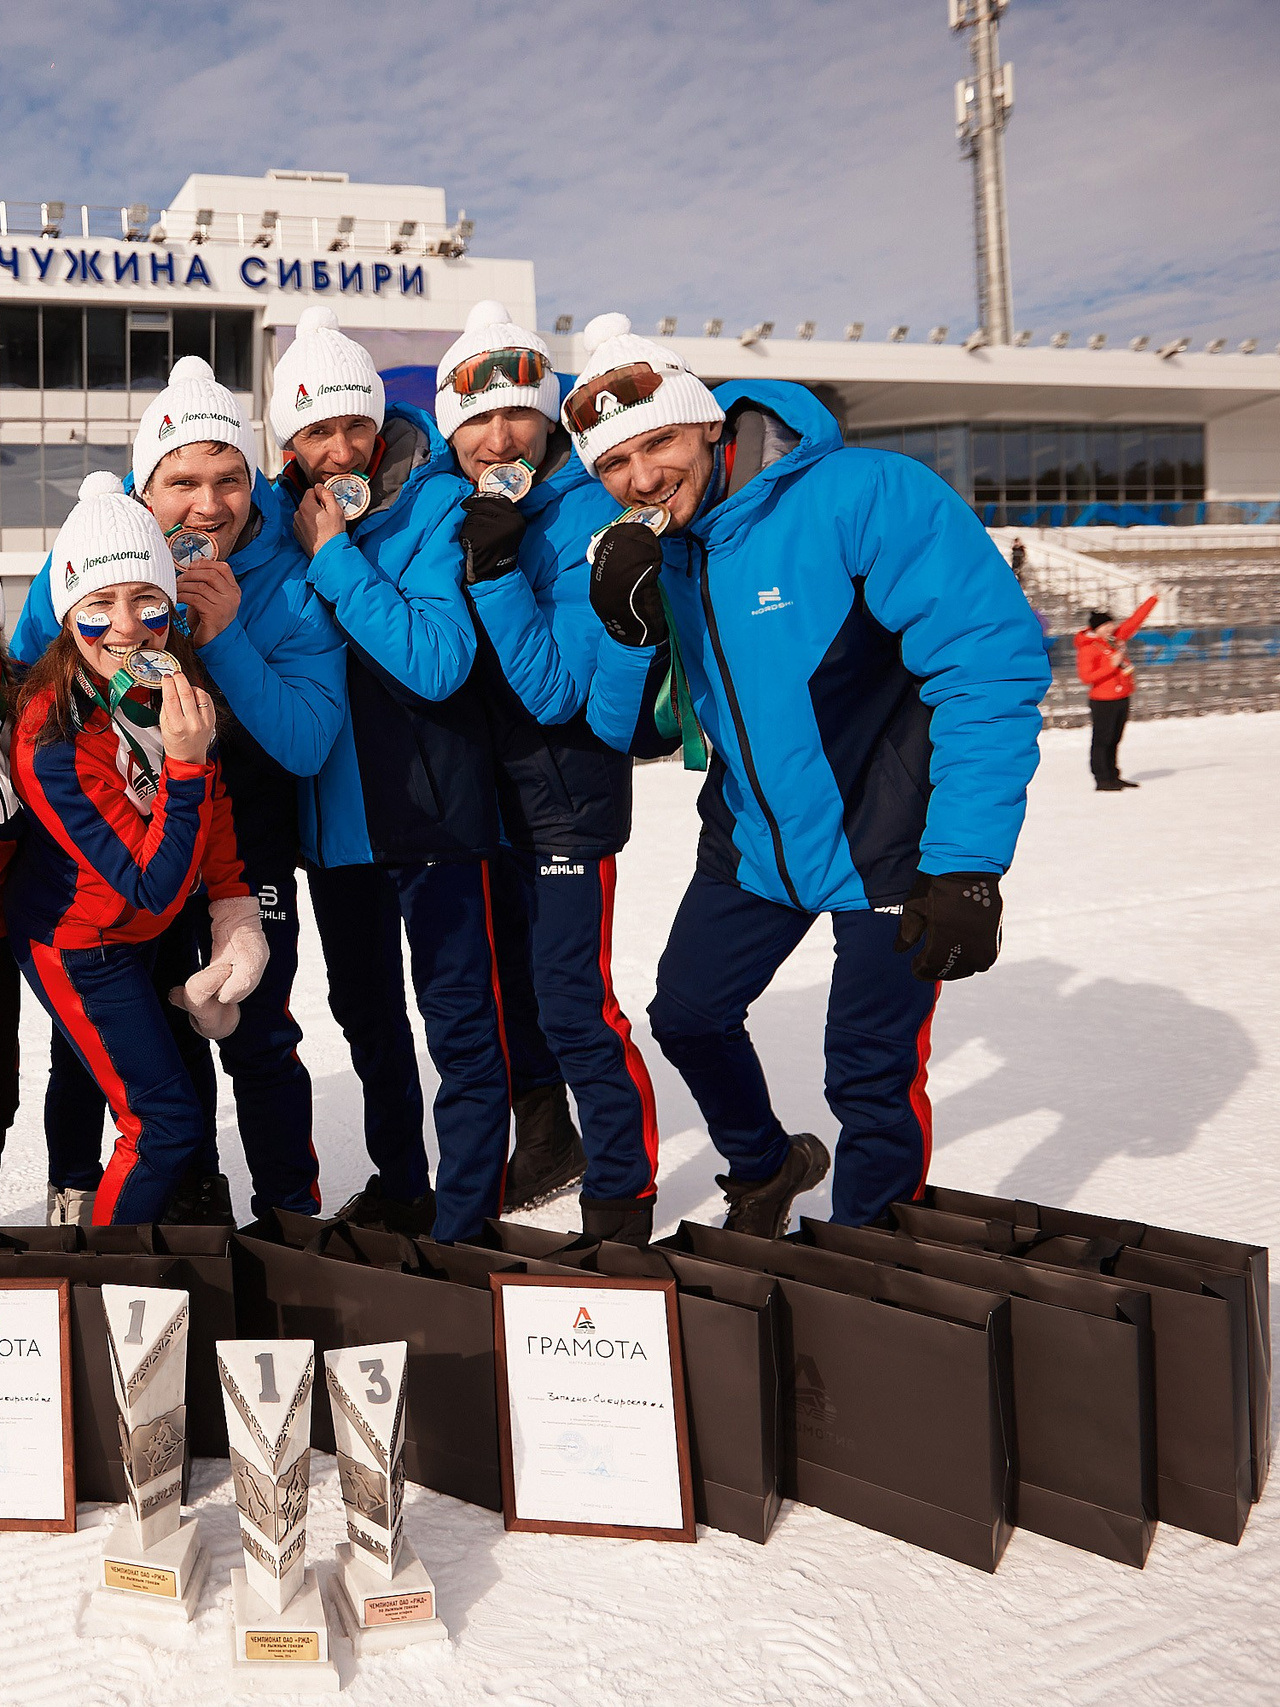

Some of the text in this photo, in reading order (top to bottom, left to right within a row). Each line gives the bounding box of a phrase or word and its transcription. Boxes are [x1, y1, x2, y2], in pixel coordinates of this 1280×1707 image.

[239, 256, 425, 294] СИБИРИ
[181, 412, 241, 428] Локомотив
[82, 550, 150, 573] Локомотив
[595, 548, 609, 582] CRAFT
[124, 1300, 146, 1345] 1
[527, 1336, 648, 1360] ГРАМОТА
[254, 1353, 280, 1403] 1
[358, 1359, 392, 1404] 3
[110, 1566, 139, 1576] ЧЕМПИОНАТ
[369, 1601, 398, 1610] ЧЕМПИОНАТ
[294, 1636, 313, 1644] «РЖД»
